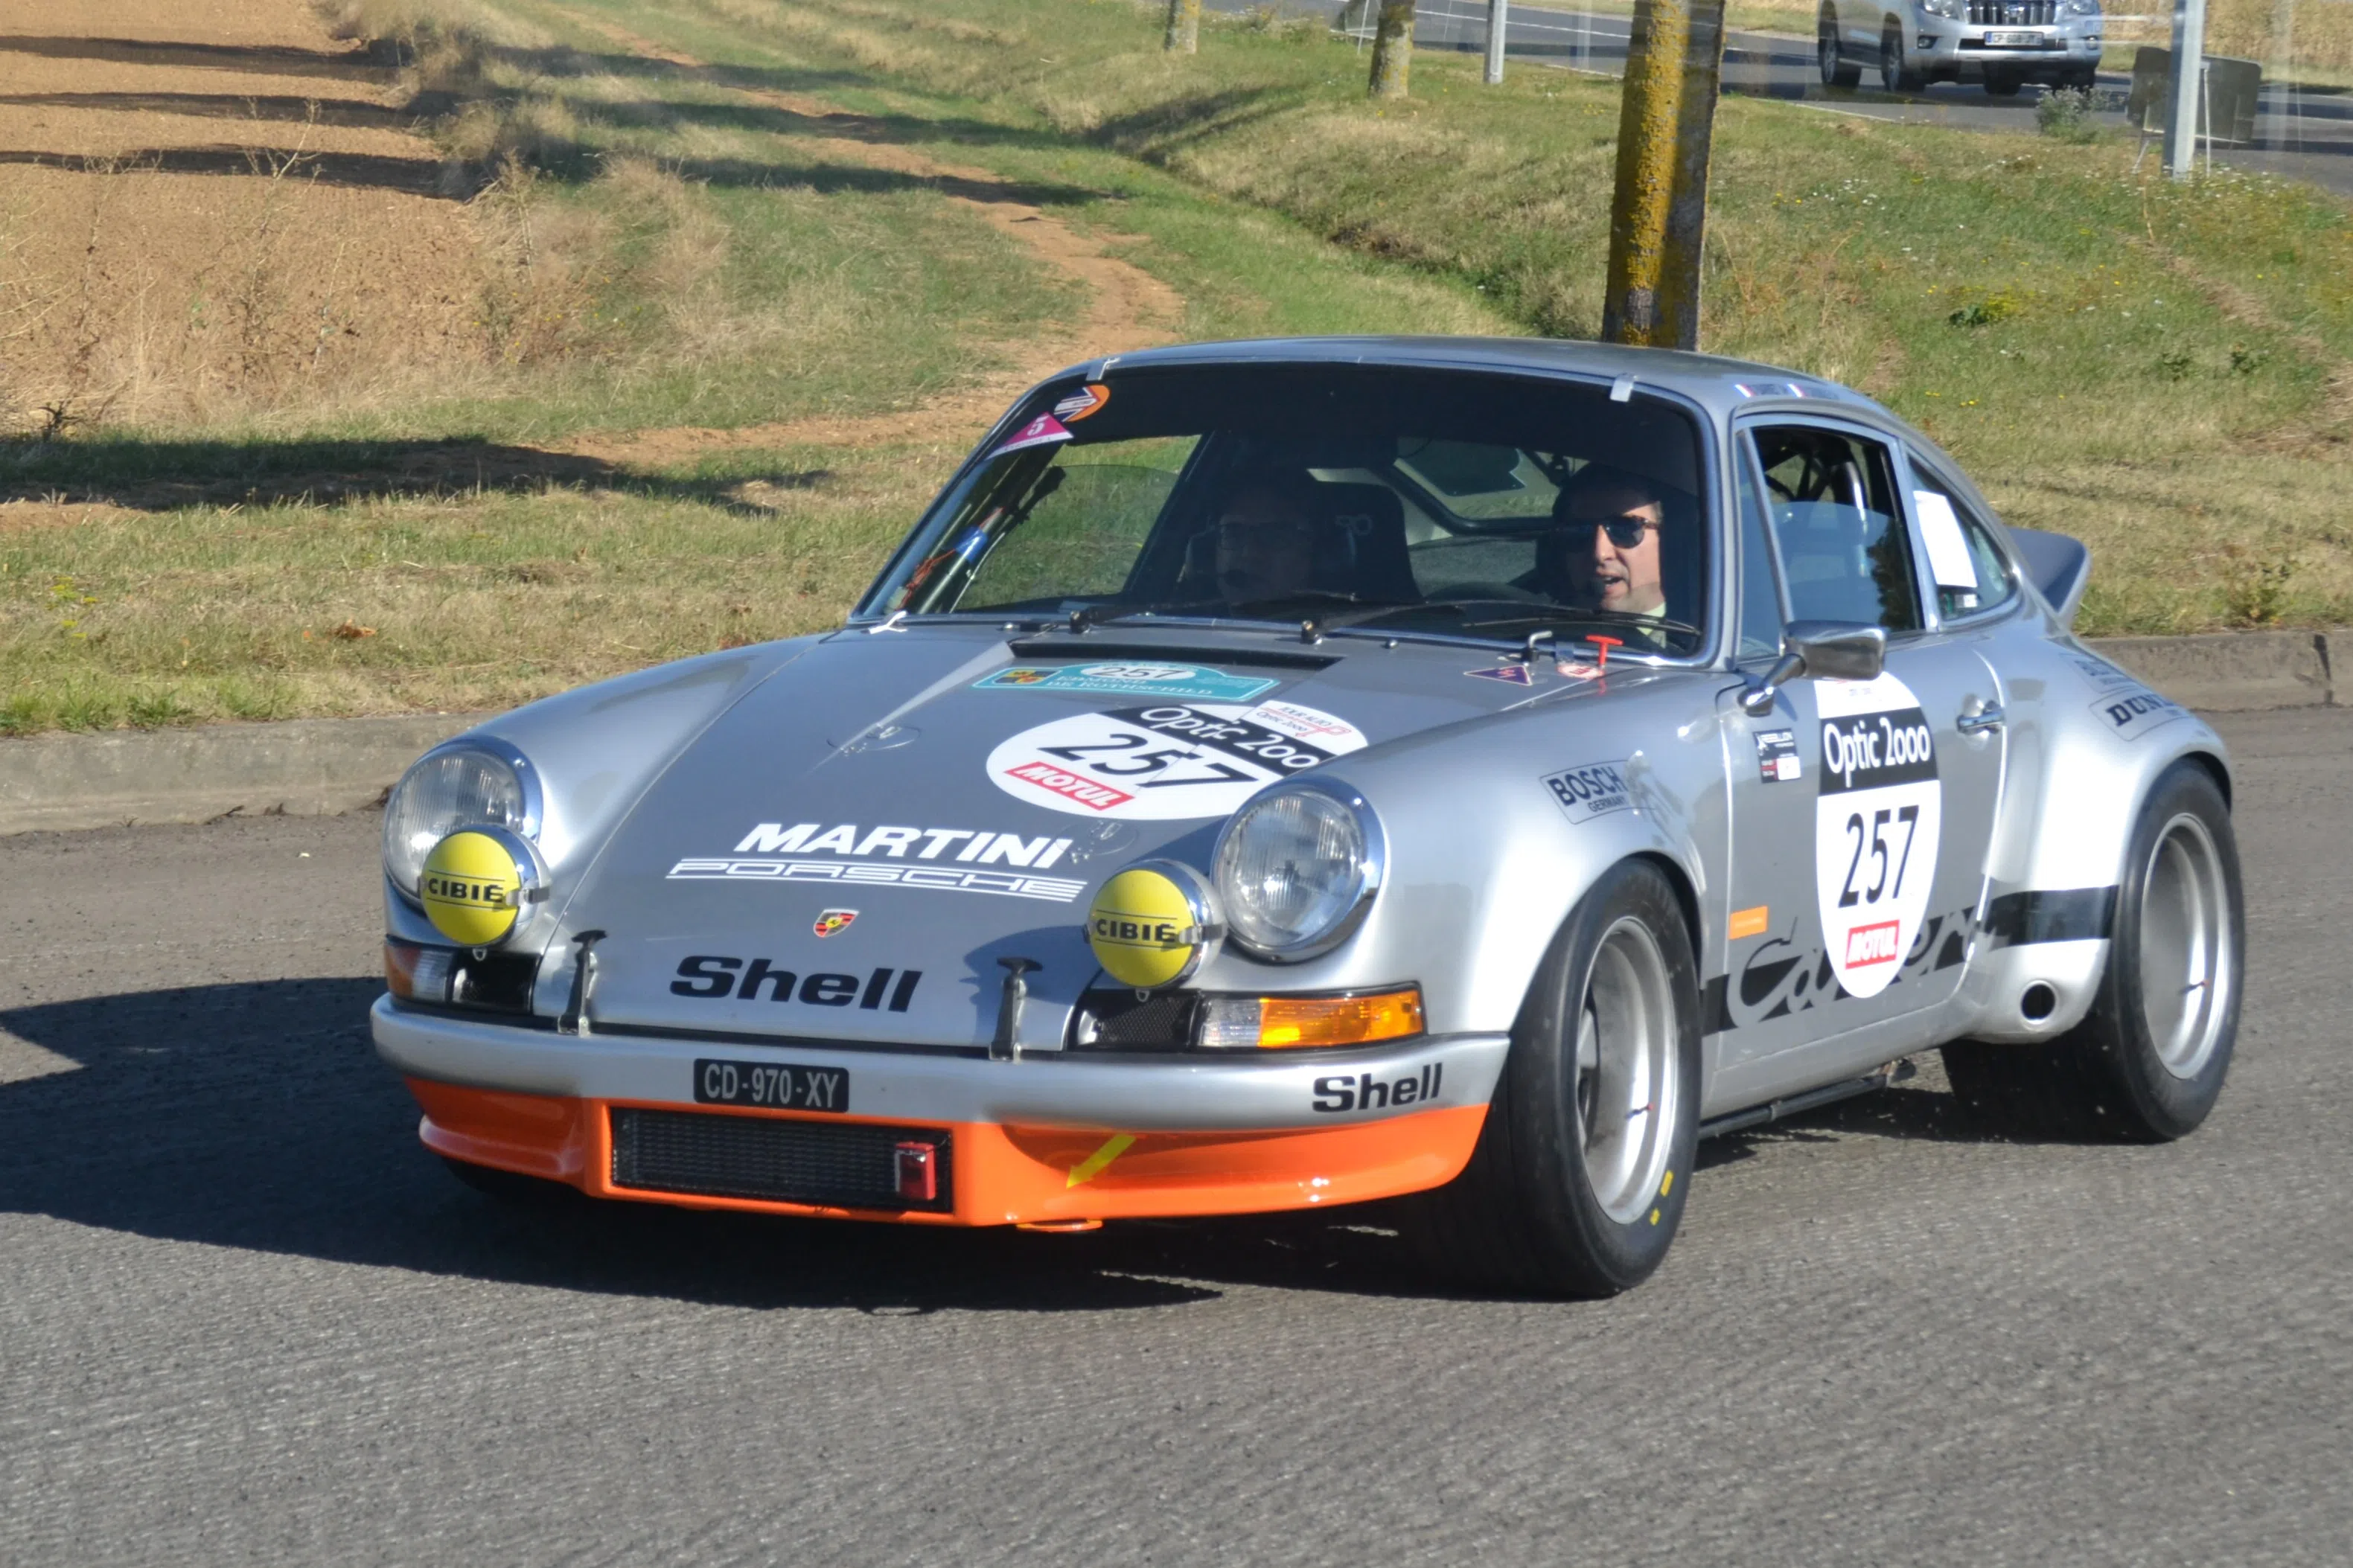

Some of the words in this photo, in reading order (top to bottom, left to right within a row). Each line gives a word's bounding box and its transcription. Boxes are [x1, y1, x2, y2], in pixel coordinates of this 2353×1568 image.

[1092, 667, 1187, 679] 257
[2106, 694, 2179, 726] DUN
[1140, 707, 1248, 739] Optic
[1233, 733, 1321, 768] 200
[1823, 720, 1880, 788] Optic
[1878, 716, 1932, 767] 2000
[1037, 734, 1259, 788] 257
[1013, 764, 1119, 806] MOTUL
[1546, 766, 1629, 806] BOSCH
[1586, 794, 1625, 812] GERMANY
[732, 823, 1073, 868] MARTINI
[1837, 804, 1920, 909] 257
[667, 861, 1087, 900] PORSCHE
[1846, 926, 1897, 964] MOTUL
[669, 955, 922, 1013] Shell
[704, 1063, 839, 1109] CD-970-XY
[1312, 1061, 1443, 1113] Shell
